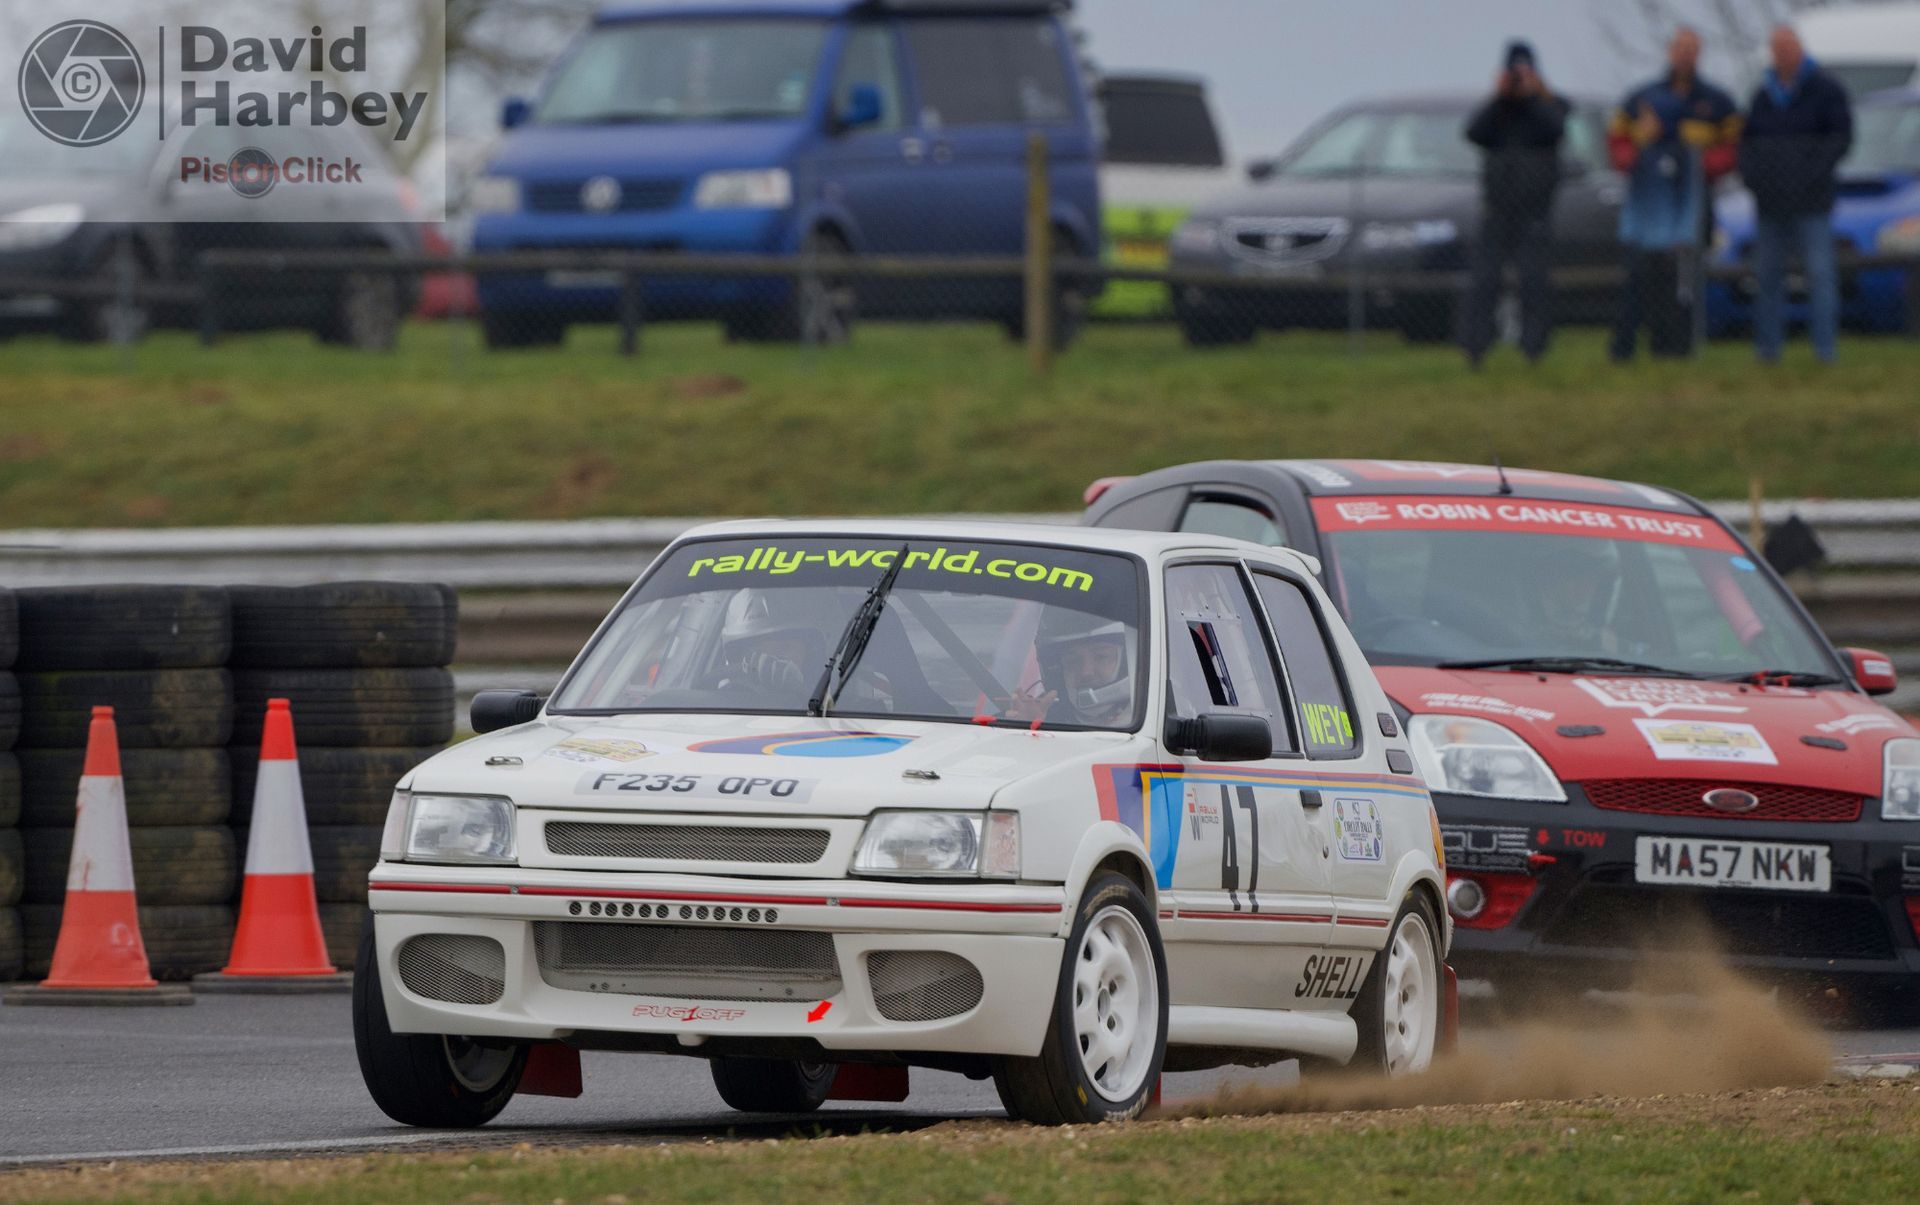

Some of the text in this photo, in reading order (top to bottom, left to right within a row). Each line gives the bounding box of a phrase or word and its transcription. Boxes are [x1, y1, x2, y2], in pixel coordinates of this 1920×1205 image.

[1396, 503, 1493, 521] ROBIN
[1497, 505, 1617, 529] CANCER
[1619, 514, 1705, 540] TRUST
[688, 547, 1093, 593] rally-world.com
[1302, 702, 1345, 745] WEY
[592, 773, 801, 797] F235 OPO
[1220, 785, 1259, 912] 47
[1562, 829, 1607, 848] TOW
[1651, 842, 1817, 883] MA57 NKW
[1295, 954, 1363, 999] SHELL
